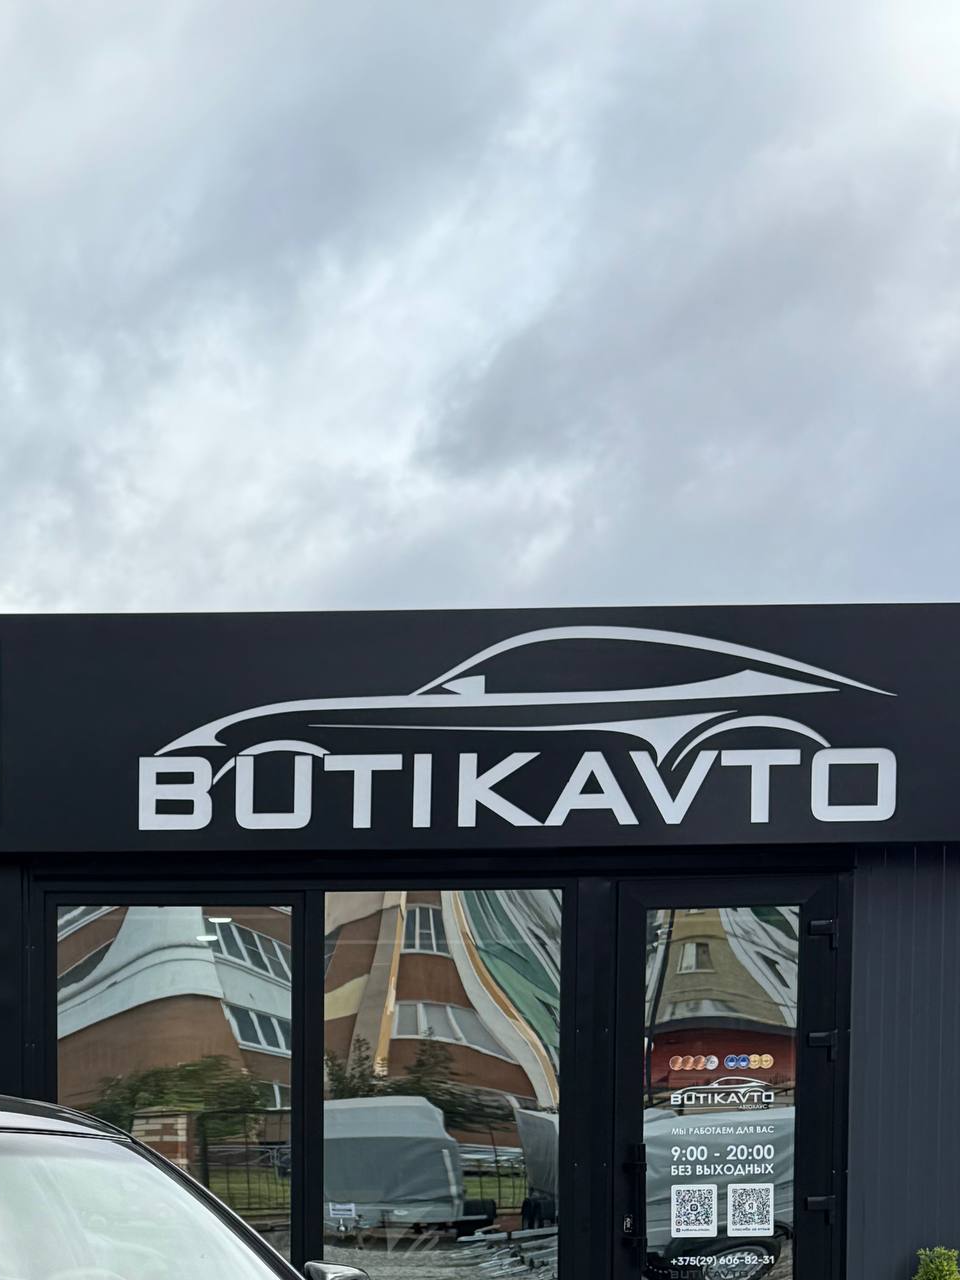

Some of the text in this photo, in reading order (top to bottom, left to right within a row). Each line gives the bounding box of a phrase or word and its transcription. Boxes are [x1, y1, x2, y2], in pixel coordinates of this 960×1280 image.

[138, 747, 897, 831] BUTIKAVTO
[670, 1092, 774, 1106] BUTIKAVTO
[671, 1126, 775, 1135] МЫ РАБОТАЕМ ДЛЯ ВАС
[671, 1145, 708, 1161] 9:00
[726, 1144, 775, 1160] 20:00
[671, 1163, 775, 1176] БЕЗ ВЫХОДНЫХ
[670, 1255, 775, 1267] +375(29) 606-82-31
